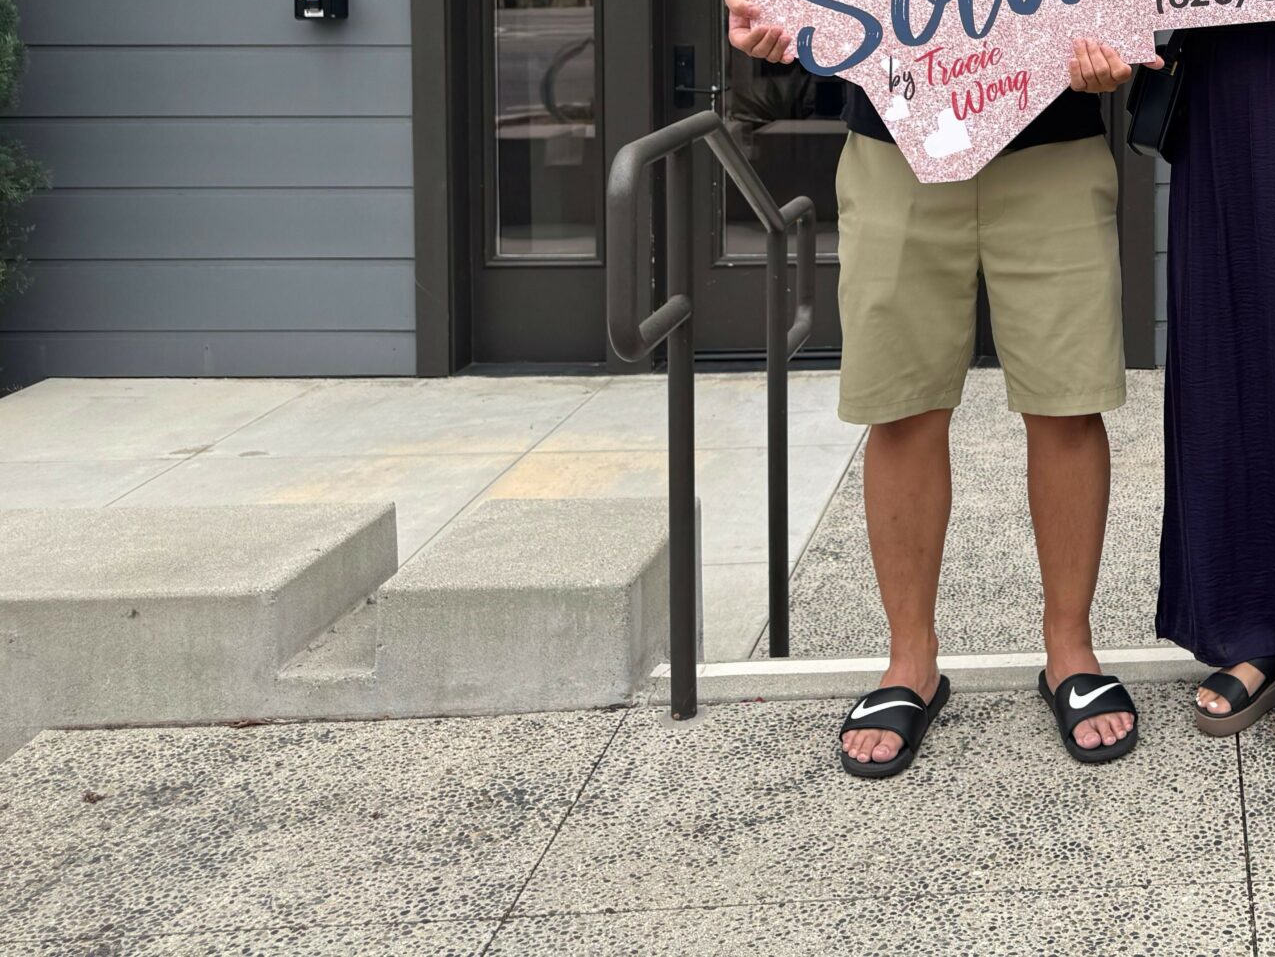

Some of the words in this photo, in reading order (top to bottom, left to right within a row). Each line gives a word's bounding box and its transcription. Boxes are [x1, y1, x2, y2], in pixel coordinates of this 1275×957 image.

[888, 55, 916, 100] by
[914, 41, 1002, 86] Tracie
[951, 70, 1030, 121] Wong
